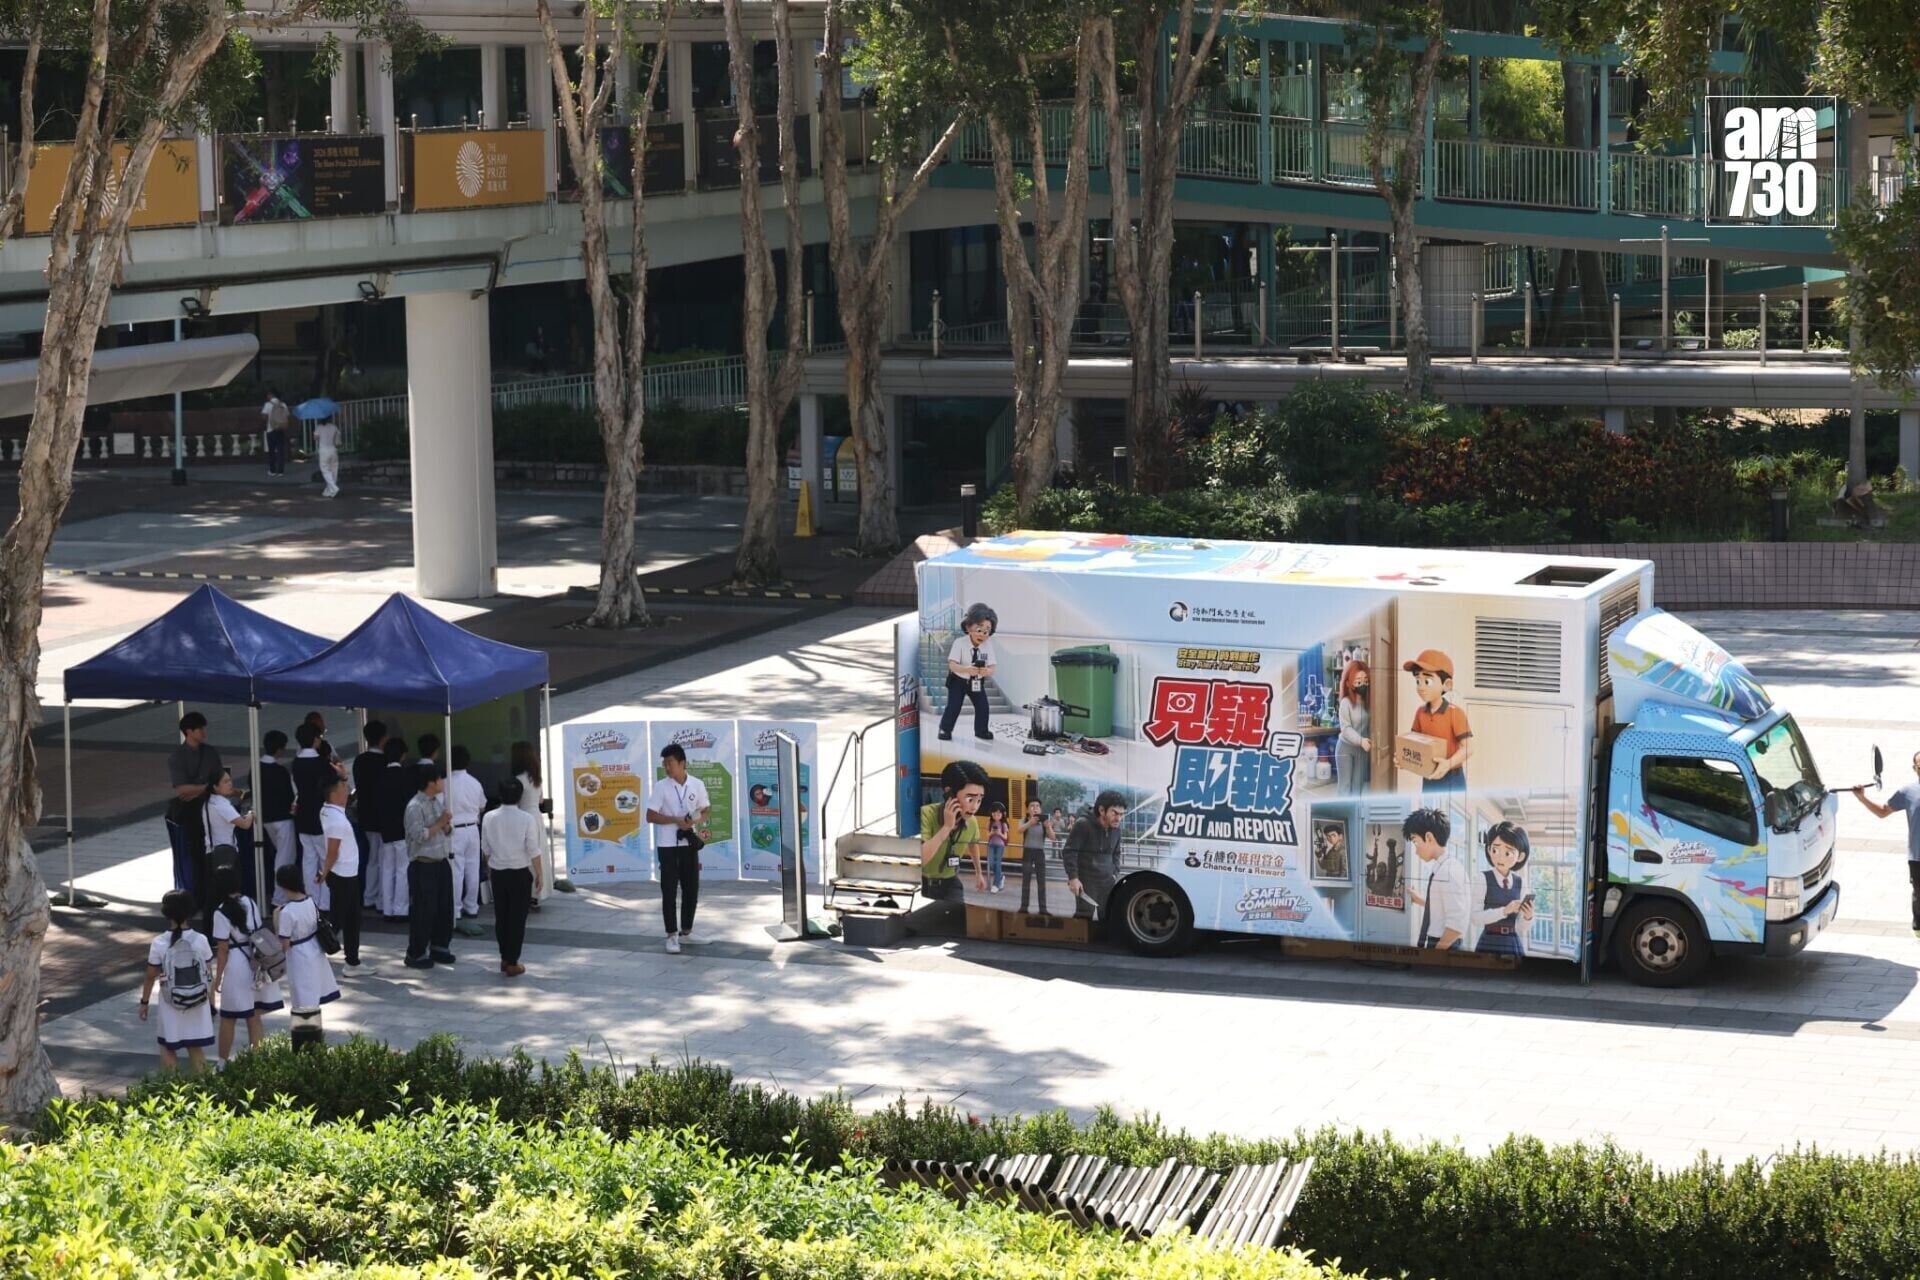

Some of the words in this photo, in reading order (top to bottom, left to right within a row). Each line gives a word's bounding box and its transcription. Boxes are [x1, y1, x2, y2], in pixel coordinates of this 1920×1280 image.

[487, 153, 508, 165] SHAW
[487, 166, 507, 177] PRIZE
[1177, 659, 1196, 669] Stay
[1231, 663, 1260, 673] Safety
[1162, 812, 1205, 836] SPOT
[1207, 821, 1232, 839] AND
[1233, 817, 1294, 843] REPORT
[1202, 862, 1232, 873] Chance
[1234, 865, 1247, 874] for
[1254, 867, 1286, 878] Reward
[1250, 887, 1282, 899] SAFE
[1236, 896, 1300, 912] COMMUNITY
